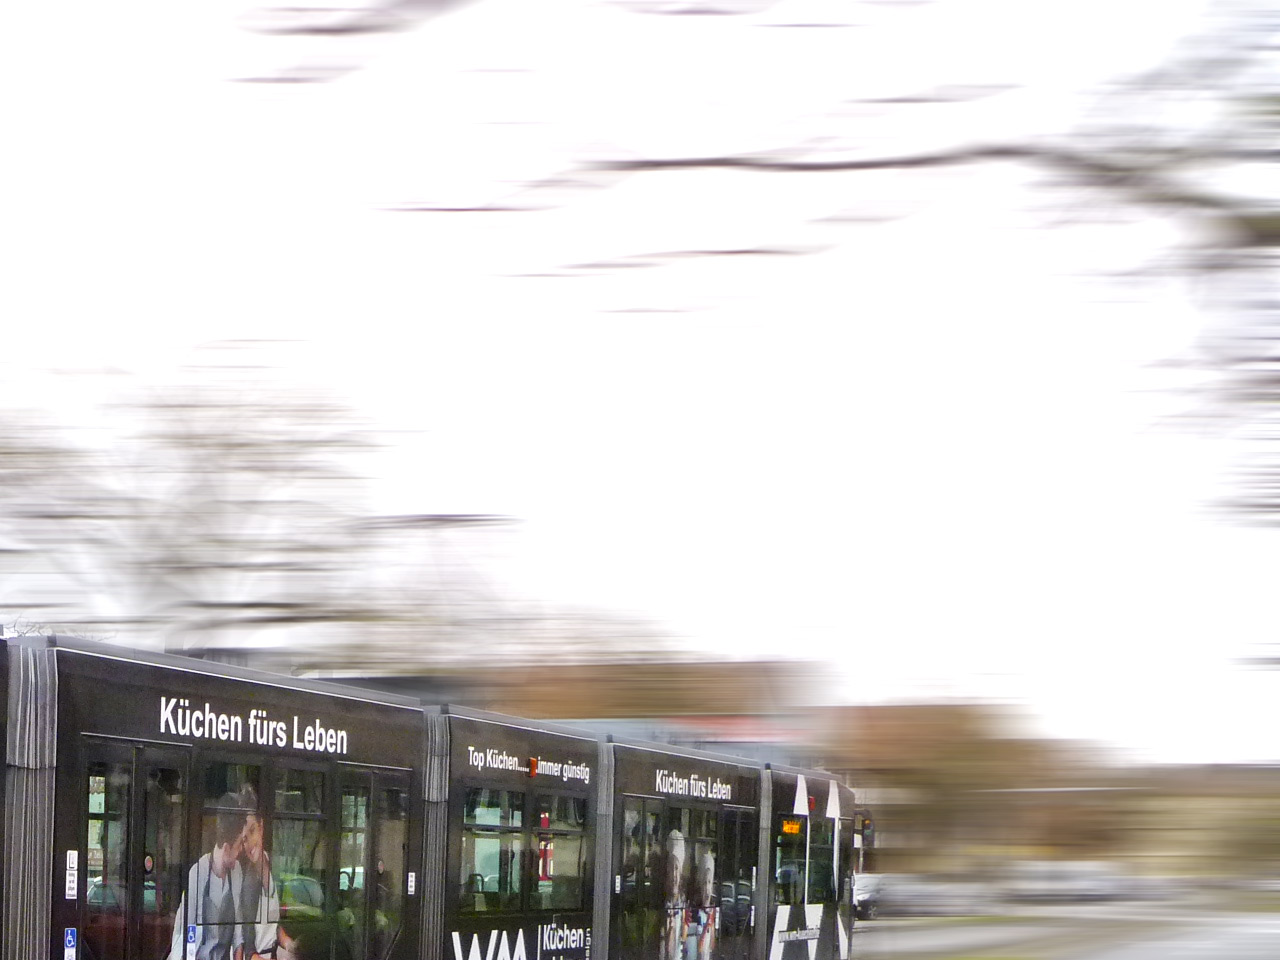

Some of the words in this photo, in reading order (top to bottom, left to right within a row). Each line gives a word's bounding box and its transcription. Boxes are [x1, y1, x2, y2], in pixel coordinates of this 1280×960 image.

[160, 697, 242, 742] Küchen
[248, 709, 287, 748] fürs
[293, 716, 347, 755] Leben
[468, 746, 484, 771] Top
[562, 760, 590, 784] günstig
[655, 769, 688, 795] Küchen
[690, 774, 706, 797] fürs
[707, 777, 731, 799] Leben
[543, 924, 584, 950] Küchen
